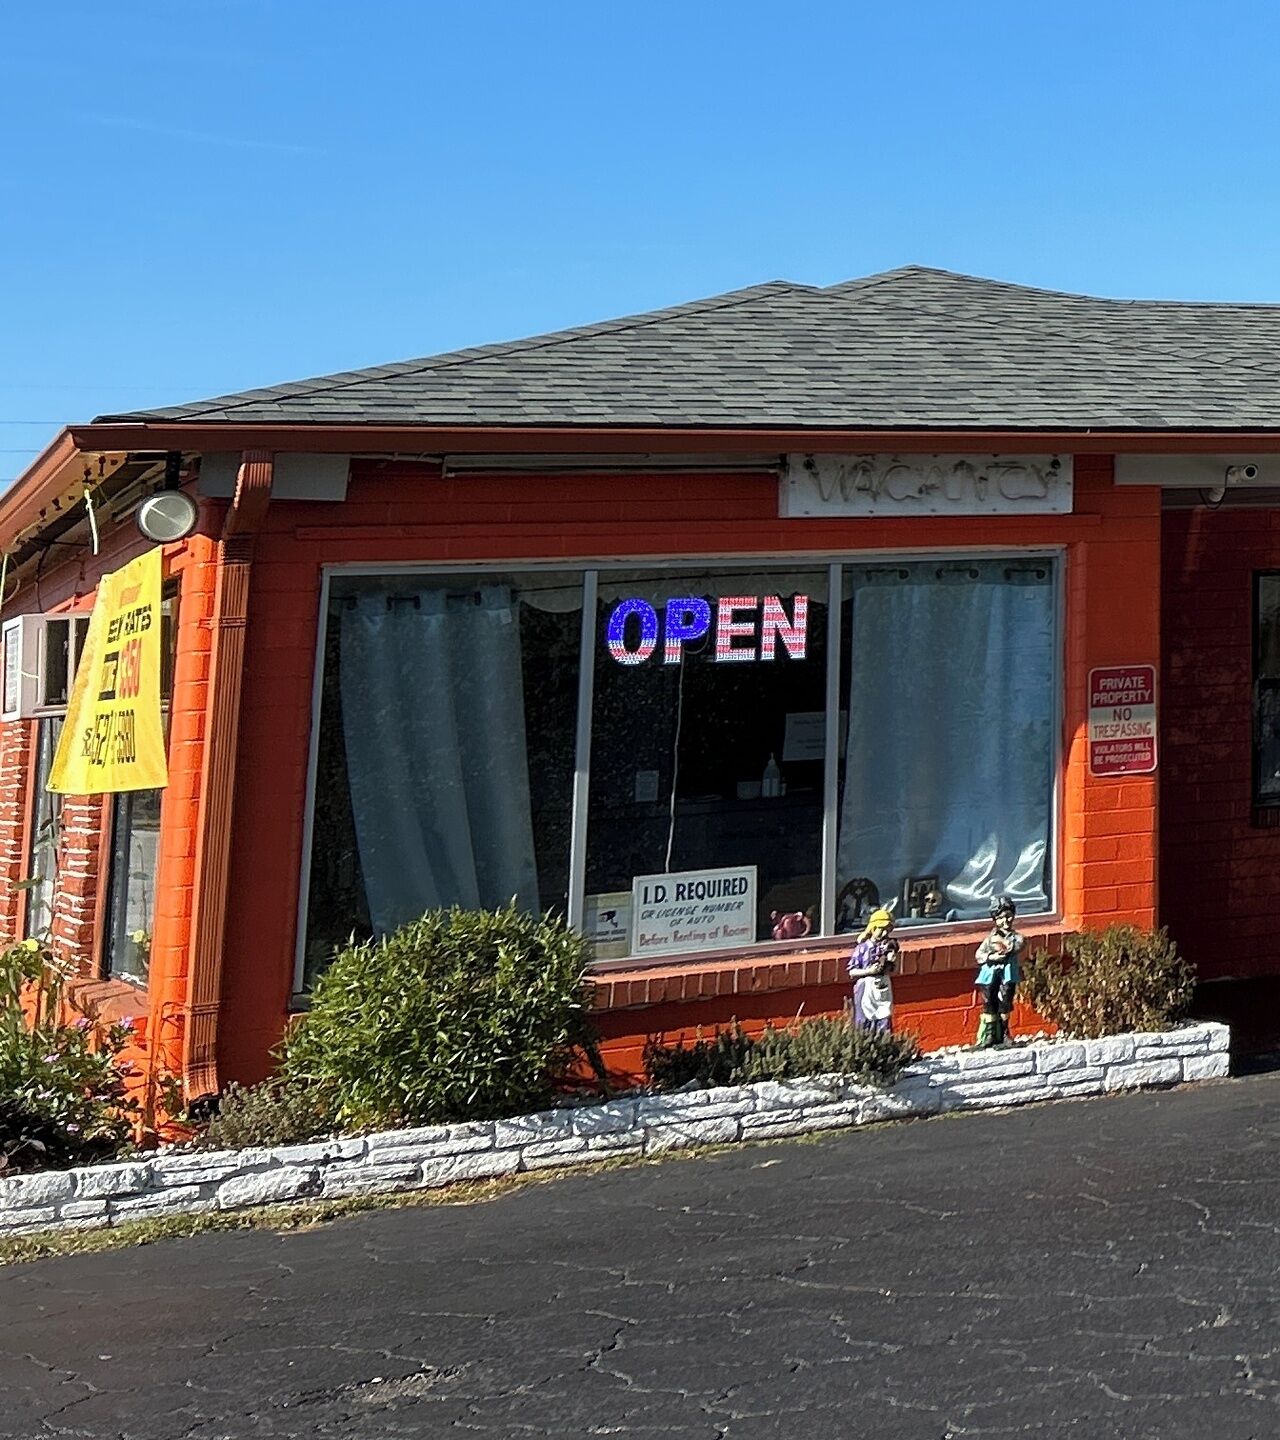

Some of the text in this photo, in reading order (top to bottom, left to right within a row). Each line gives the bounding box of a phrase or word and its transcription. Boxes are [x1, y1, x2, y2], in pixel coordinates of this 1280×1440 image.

[608, 595, 808, 665] OPEN
[1100, 676, 1145, 690] PRIVATE
[1093, 689, 1151, 704] PROPERTY
[1112, 708, 1132, 721] NO
[1093, 722, 1152, 738] TRESPASSING
[1094, 742, 1151, 754] VIOLATORS WILL
[1094, 752, 1152, 765] BE PROSECUTED
[643, 876, 749, 905] I.D. REQUIRED
[656, 905, 696, 920] LICENSE
[702, 901, 744, 914] NUMBER
[686, 915, 715, 926] AUTO
[639, 933, 669, 947] Before
[709, 927, 721, 939] of
[723, 925, 750, 937] Room
